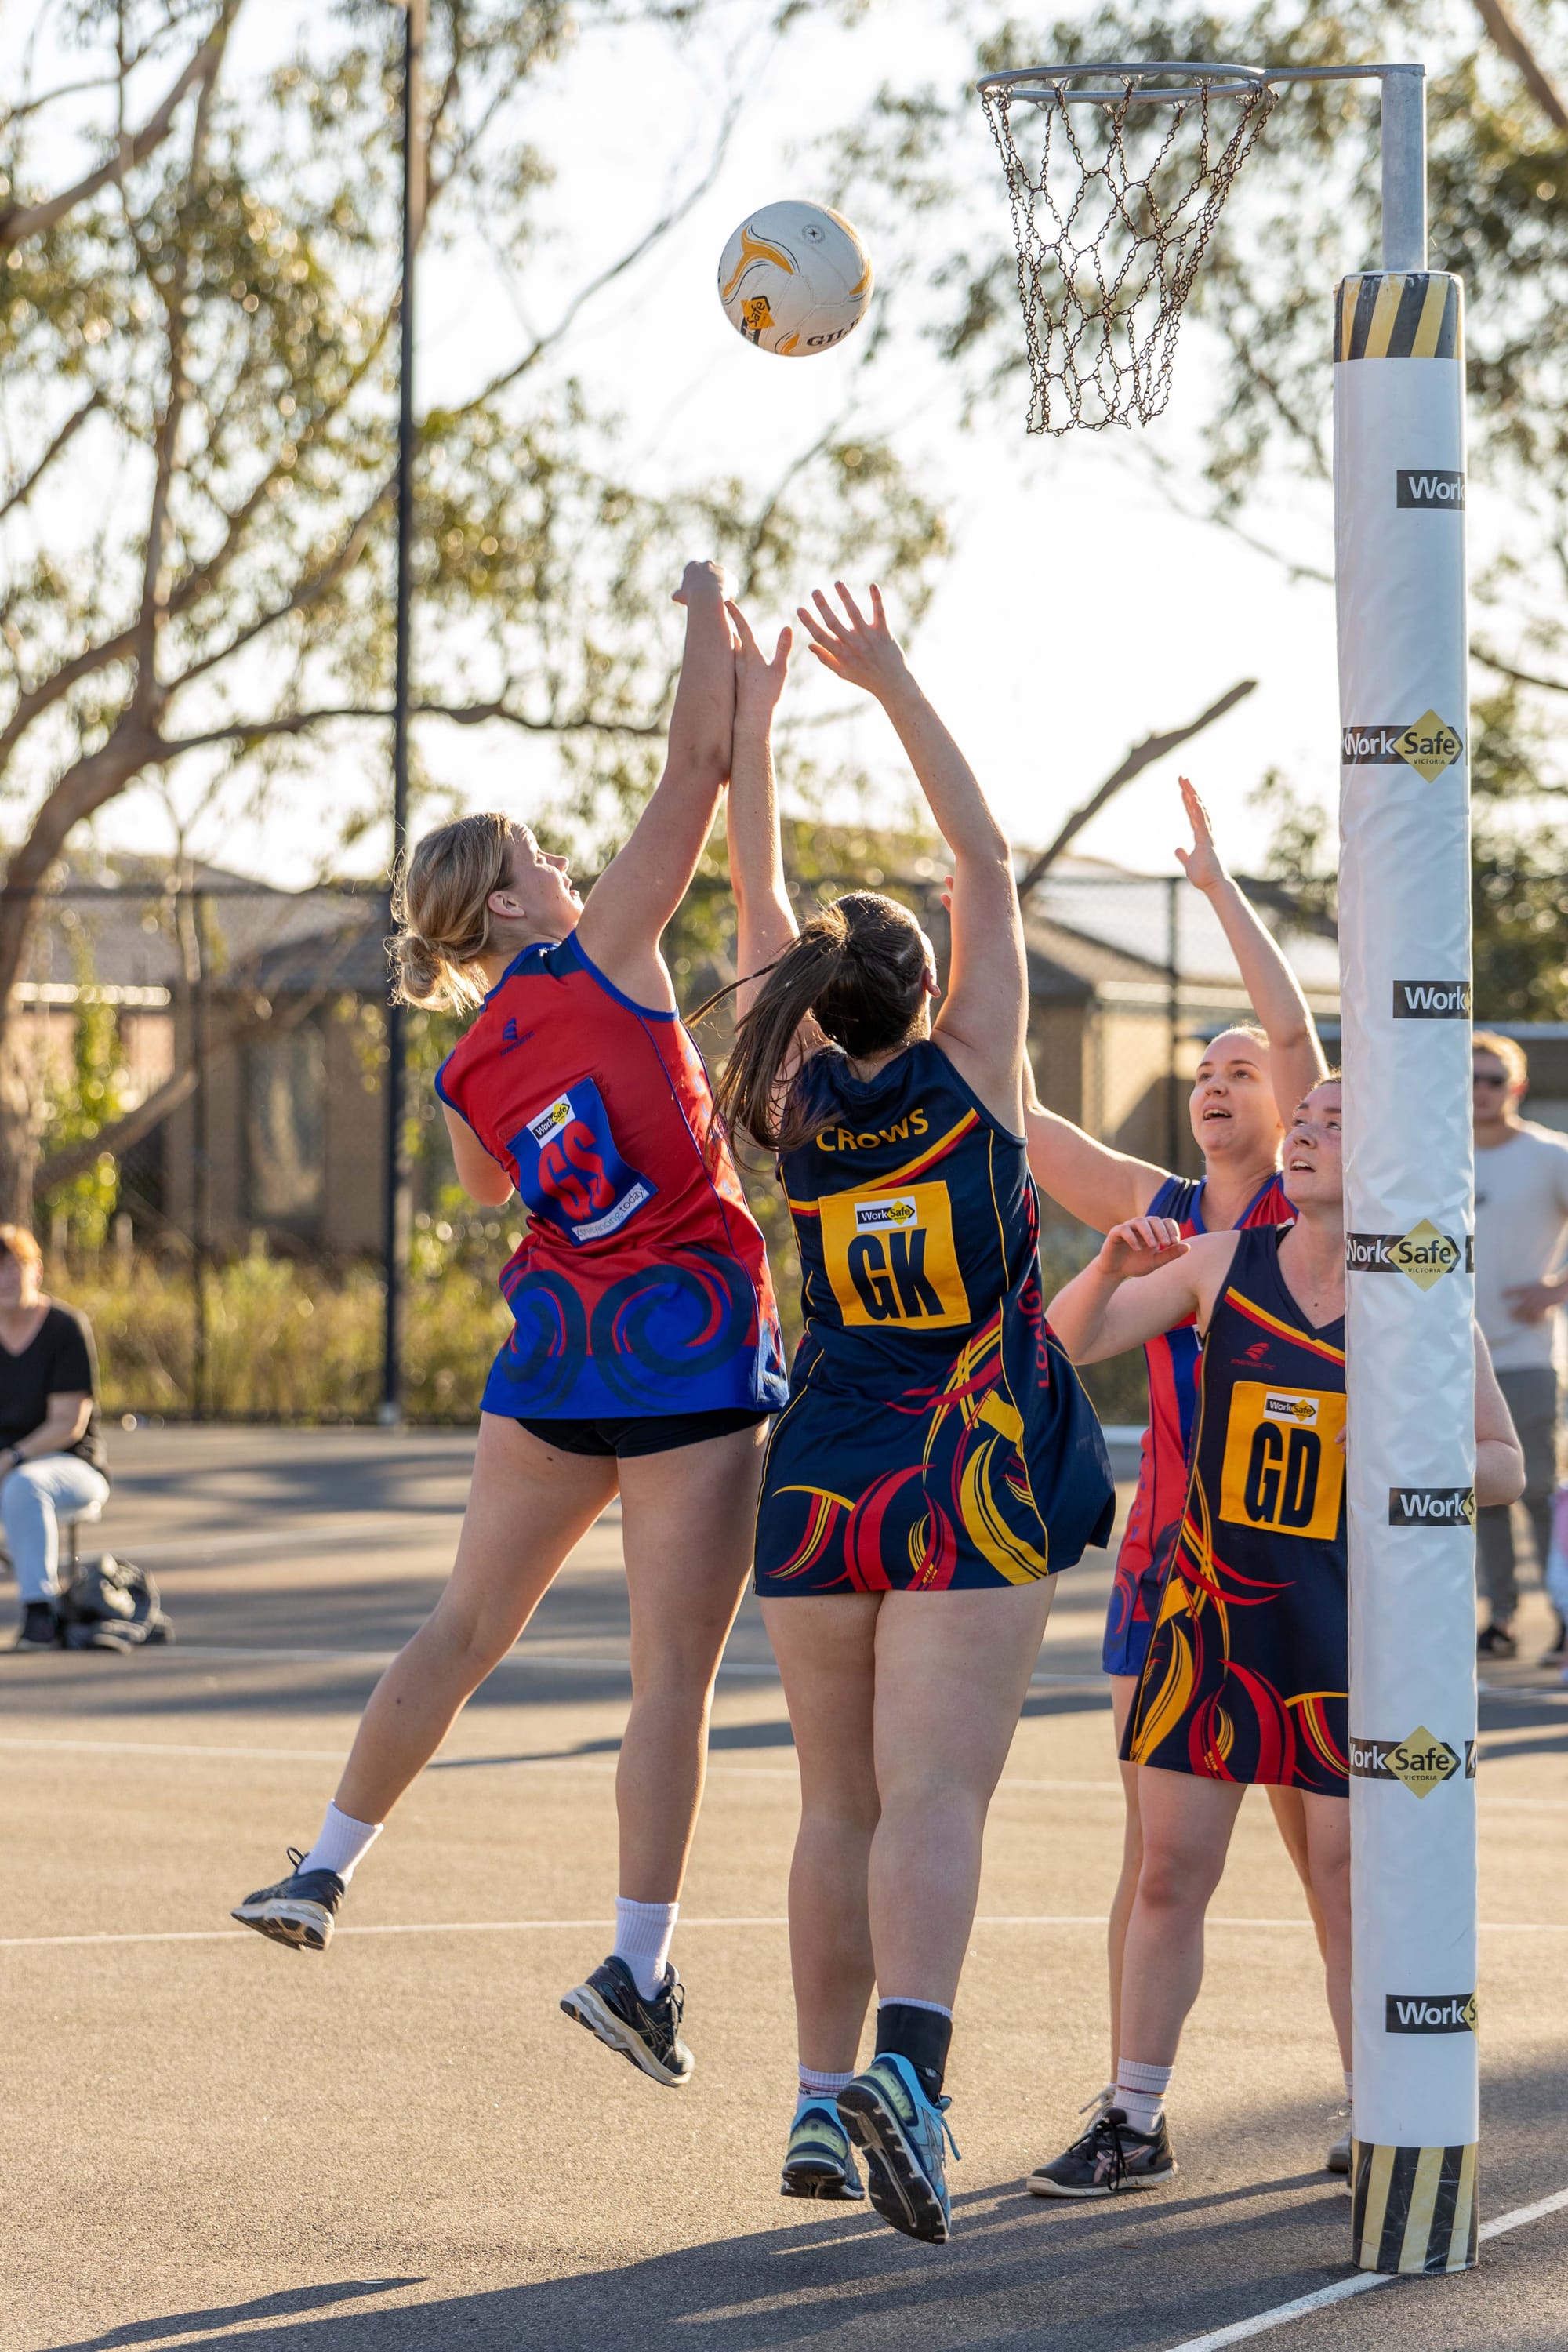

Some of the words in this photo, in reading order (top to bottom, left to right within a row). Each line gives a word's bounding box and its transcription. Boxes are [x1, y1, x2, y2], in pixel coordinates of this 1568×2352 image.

[538, 1120, 615, 1221] GS
[816, 1108, 929, 1152] CROWS
[848, 1228, 946, 1321] GK
[1244, 1421, 1321, 1528] GD
